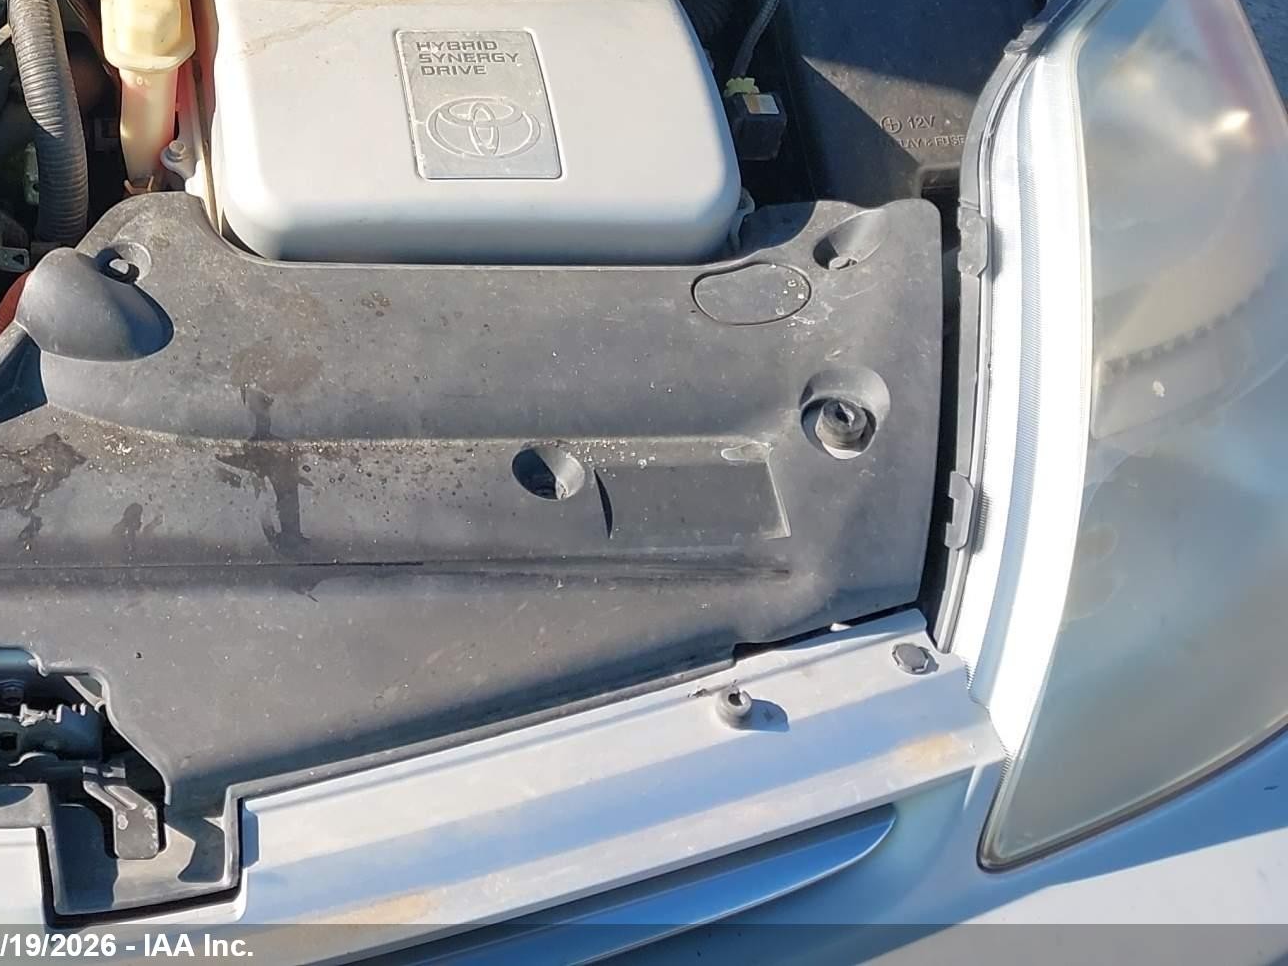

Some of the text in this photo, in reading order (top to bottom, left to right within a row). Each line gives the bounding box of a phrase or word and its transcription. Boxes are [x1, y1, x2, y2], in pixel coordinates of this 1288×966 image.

[416, 40, 498, 51] HYBRID
[418, 52, 519, 63] SYNERGY
[420, 65, 487, 76] DRIVE
[906, 115, 936, 130] 12V
